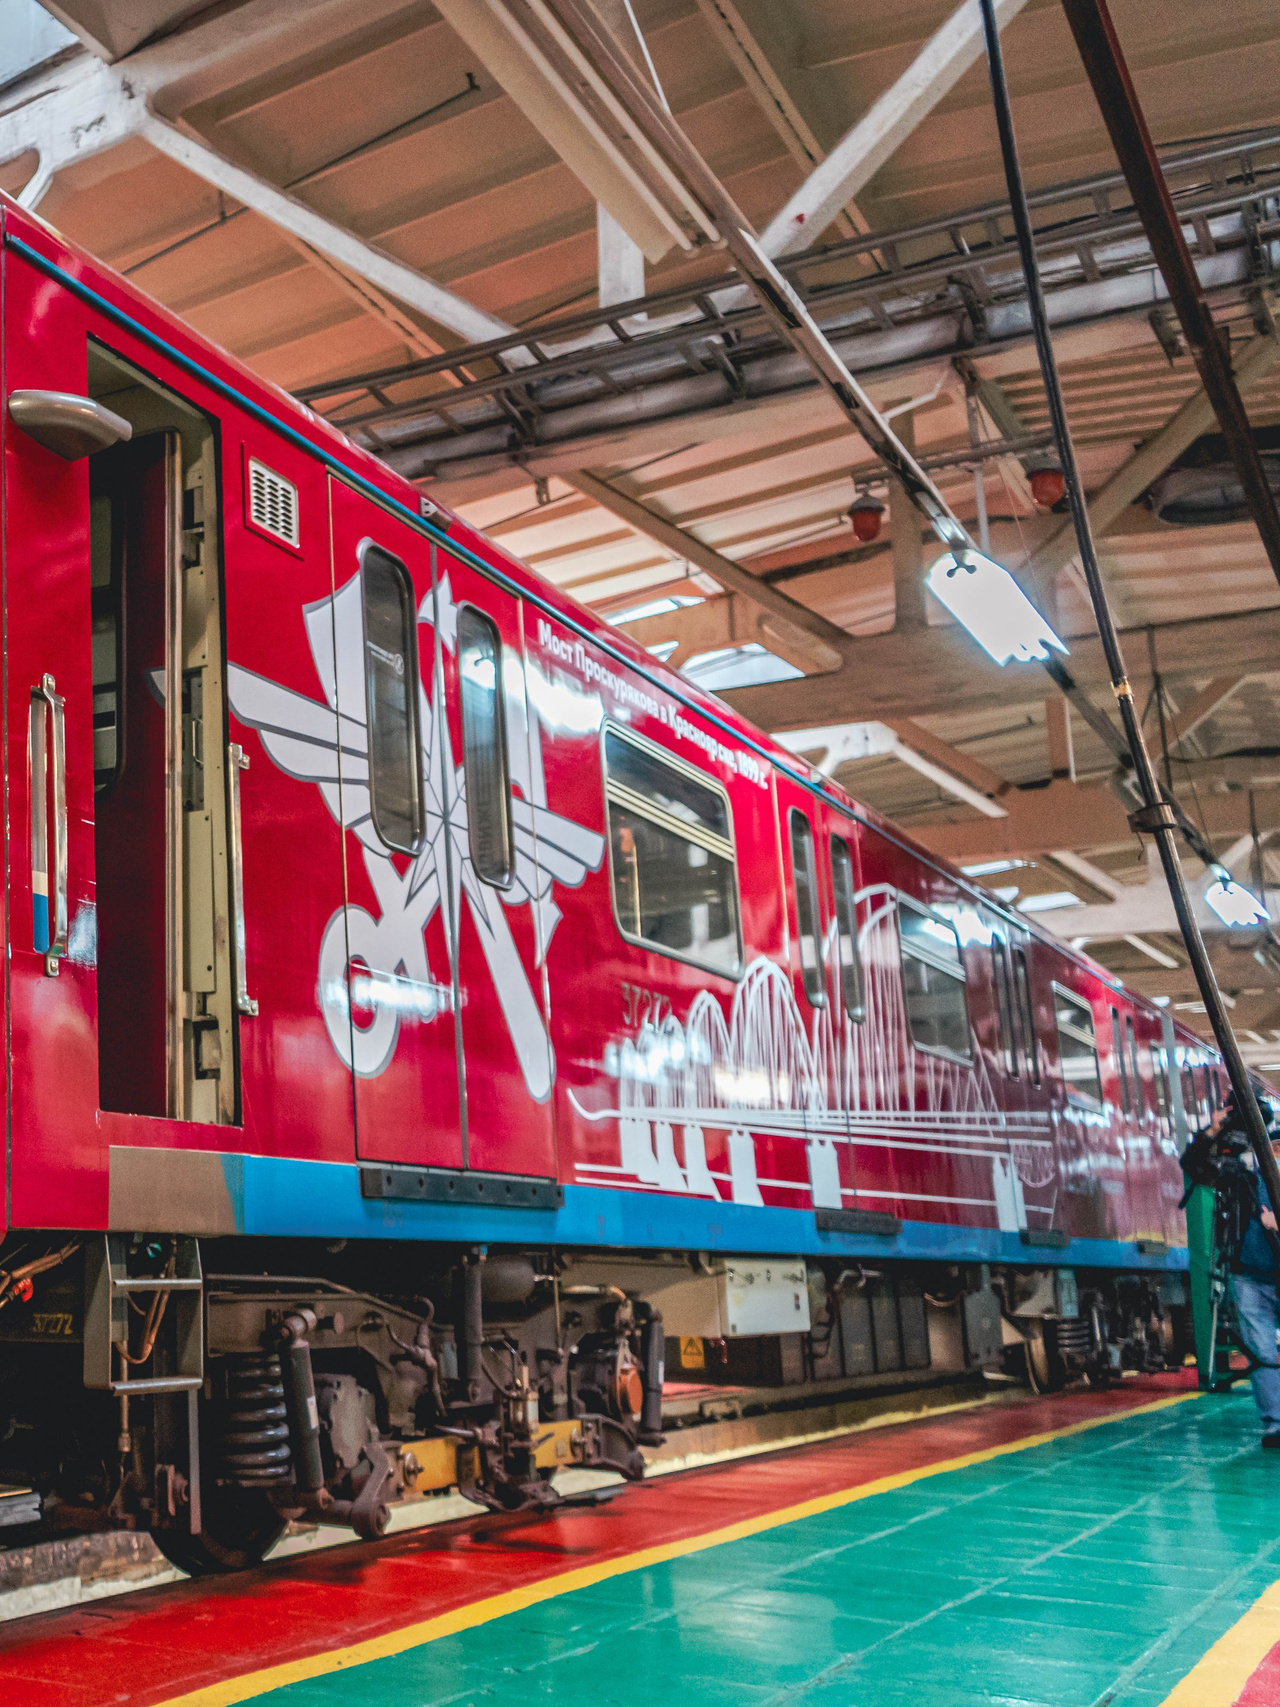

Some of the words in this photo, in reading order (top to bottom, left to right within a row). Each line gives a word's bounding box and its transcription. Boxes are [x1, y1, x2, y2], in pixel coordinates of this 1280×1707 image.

[537, 618, 573, 663] Мост
[574, 642, 660, 719] Проскурякова
[621, 982, 675, 1036] 37272
